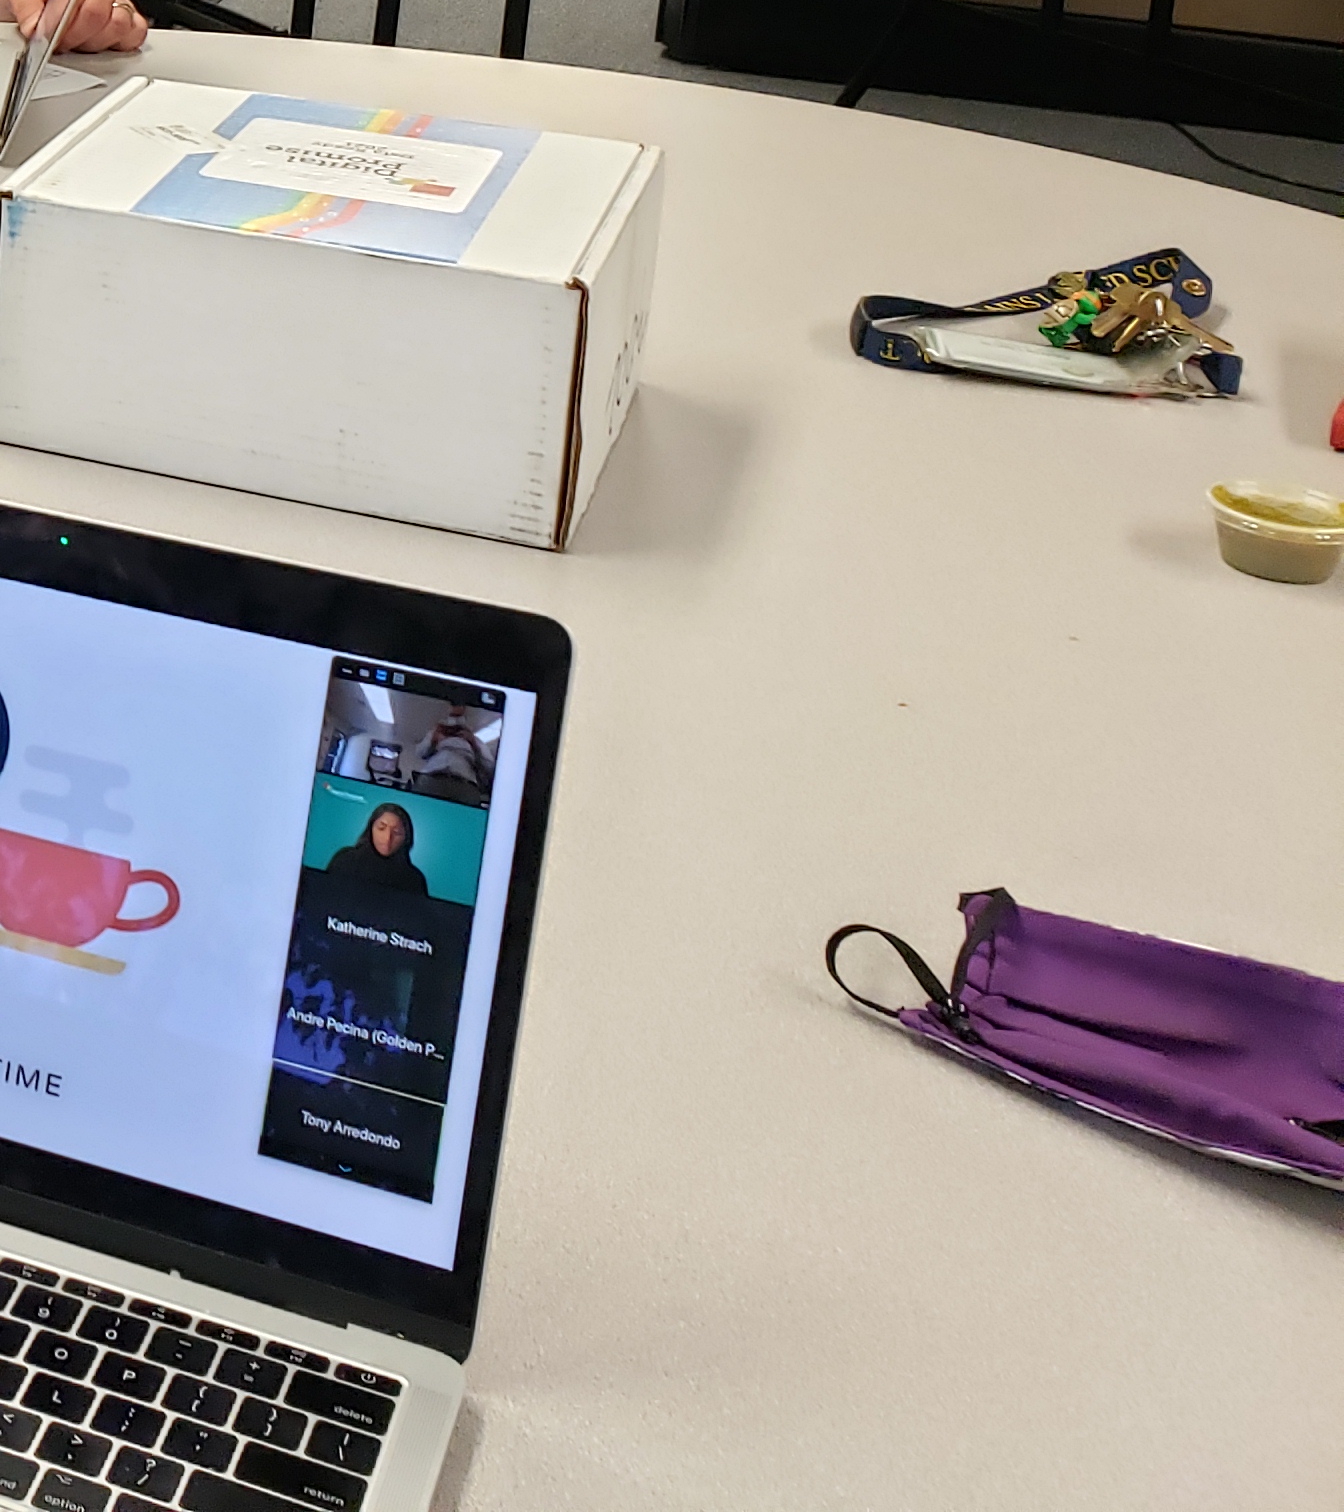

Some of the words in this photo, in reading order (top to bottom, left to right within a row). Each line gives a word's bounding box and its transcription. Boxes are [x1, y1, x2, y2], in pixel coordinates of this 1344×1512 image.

[265, 143, 407, 171] Promise
[286, 155, 398, 178] Digital
[327, 916, 388, 946] Katherine
[390, 930, 433, 956] Strach
[287, 1005, 324, 1029] Andre
[327, 1015, 369, 1041] Pecina
[372, 1026, 423, 1054] (Golden
[300, 1109, 330, 1134] Tony
[331, 1119, 401, 1150] Arredondo
[334, 1403, 373, 1425] delete
[45, 1492, 86, 1512] option
[303, 1484, 344, 1507] return
